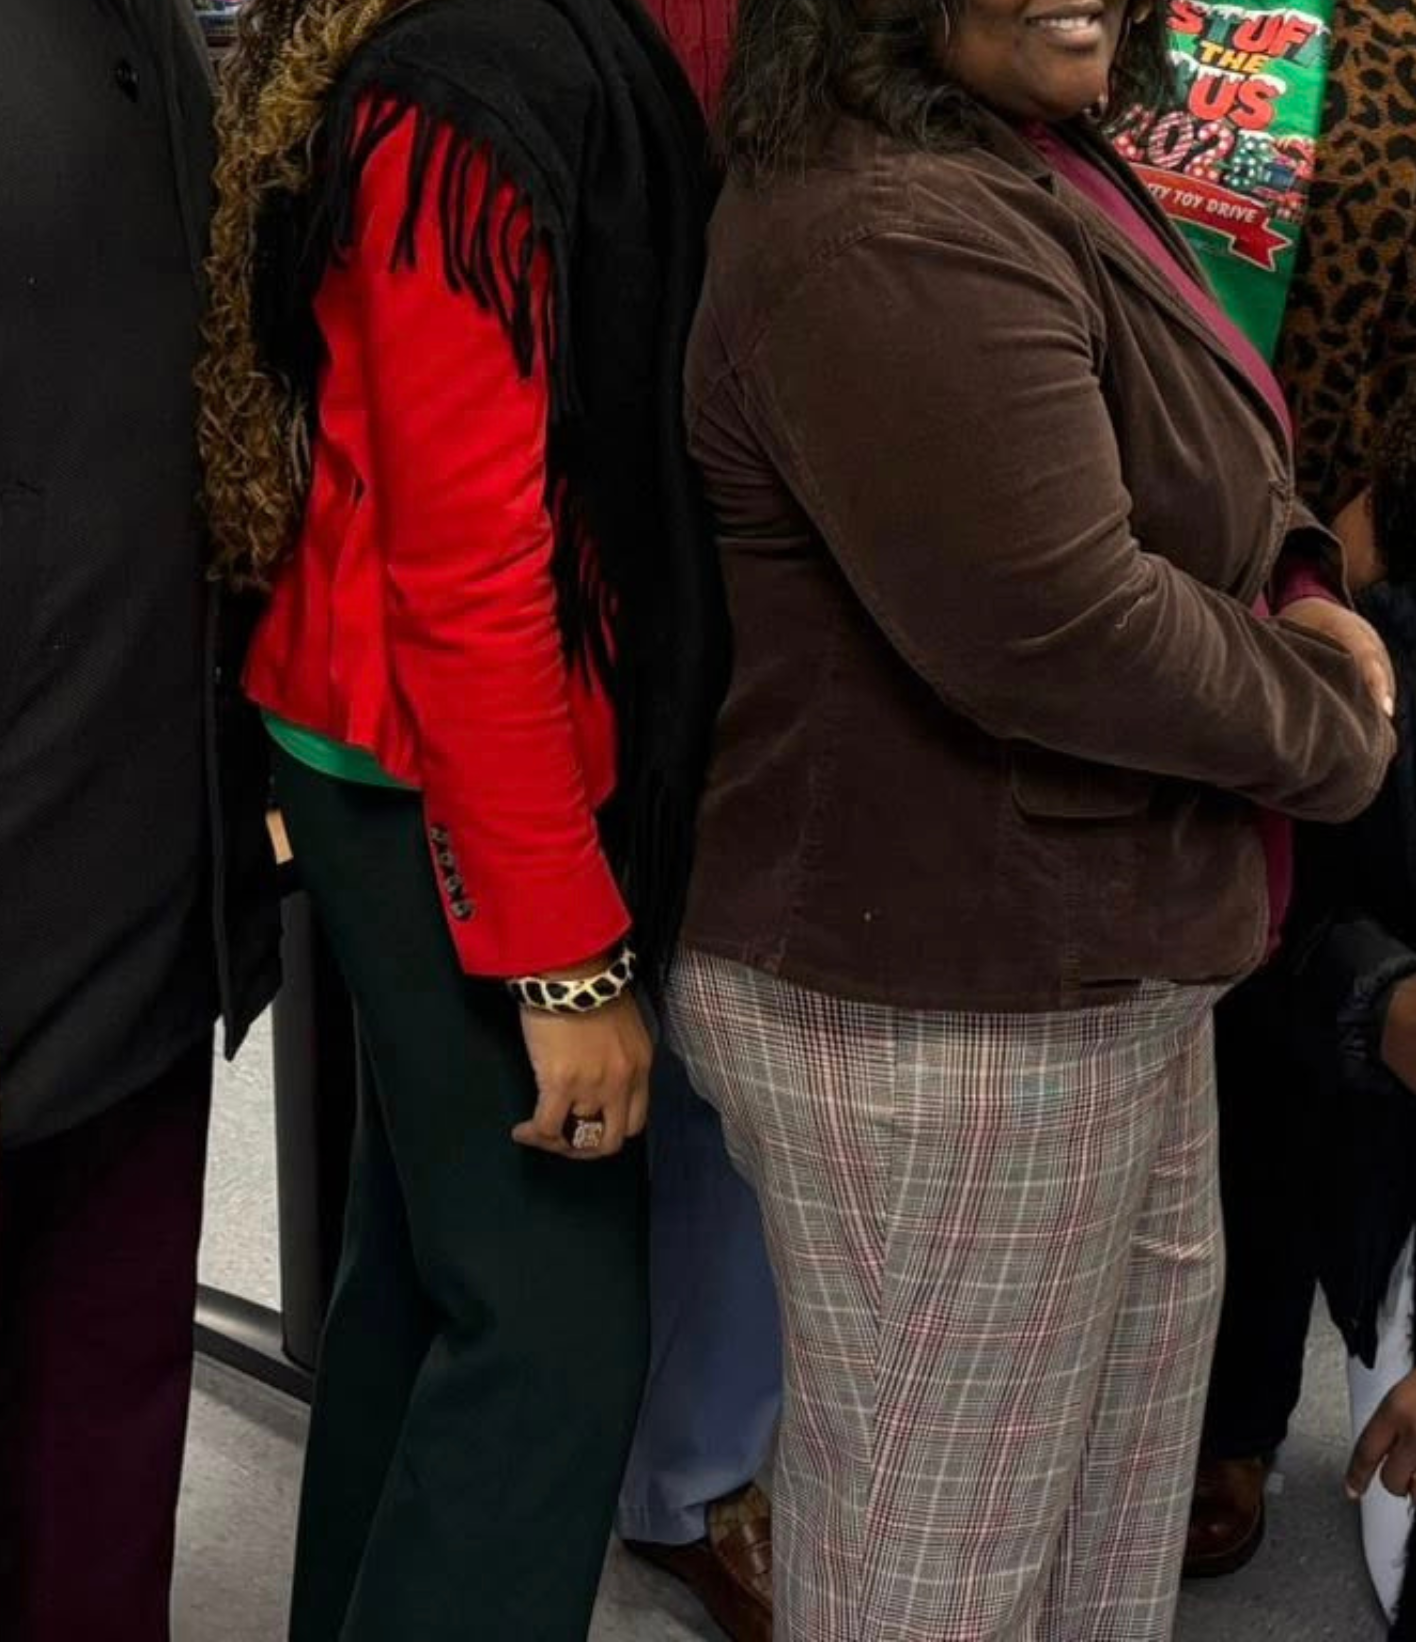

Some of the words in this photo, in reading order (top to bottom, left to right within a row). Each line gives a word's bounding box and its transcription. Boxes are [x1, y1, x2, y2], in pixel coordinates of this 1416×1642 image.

[1200, 39, 1270, 74] THE
[1172, 189, 1204, 210] TOY
[1206, 198, 1260, 224] DRIVE
